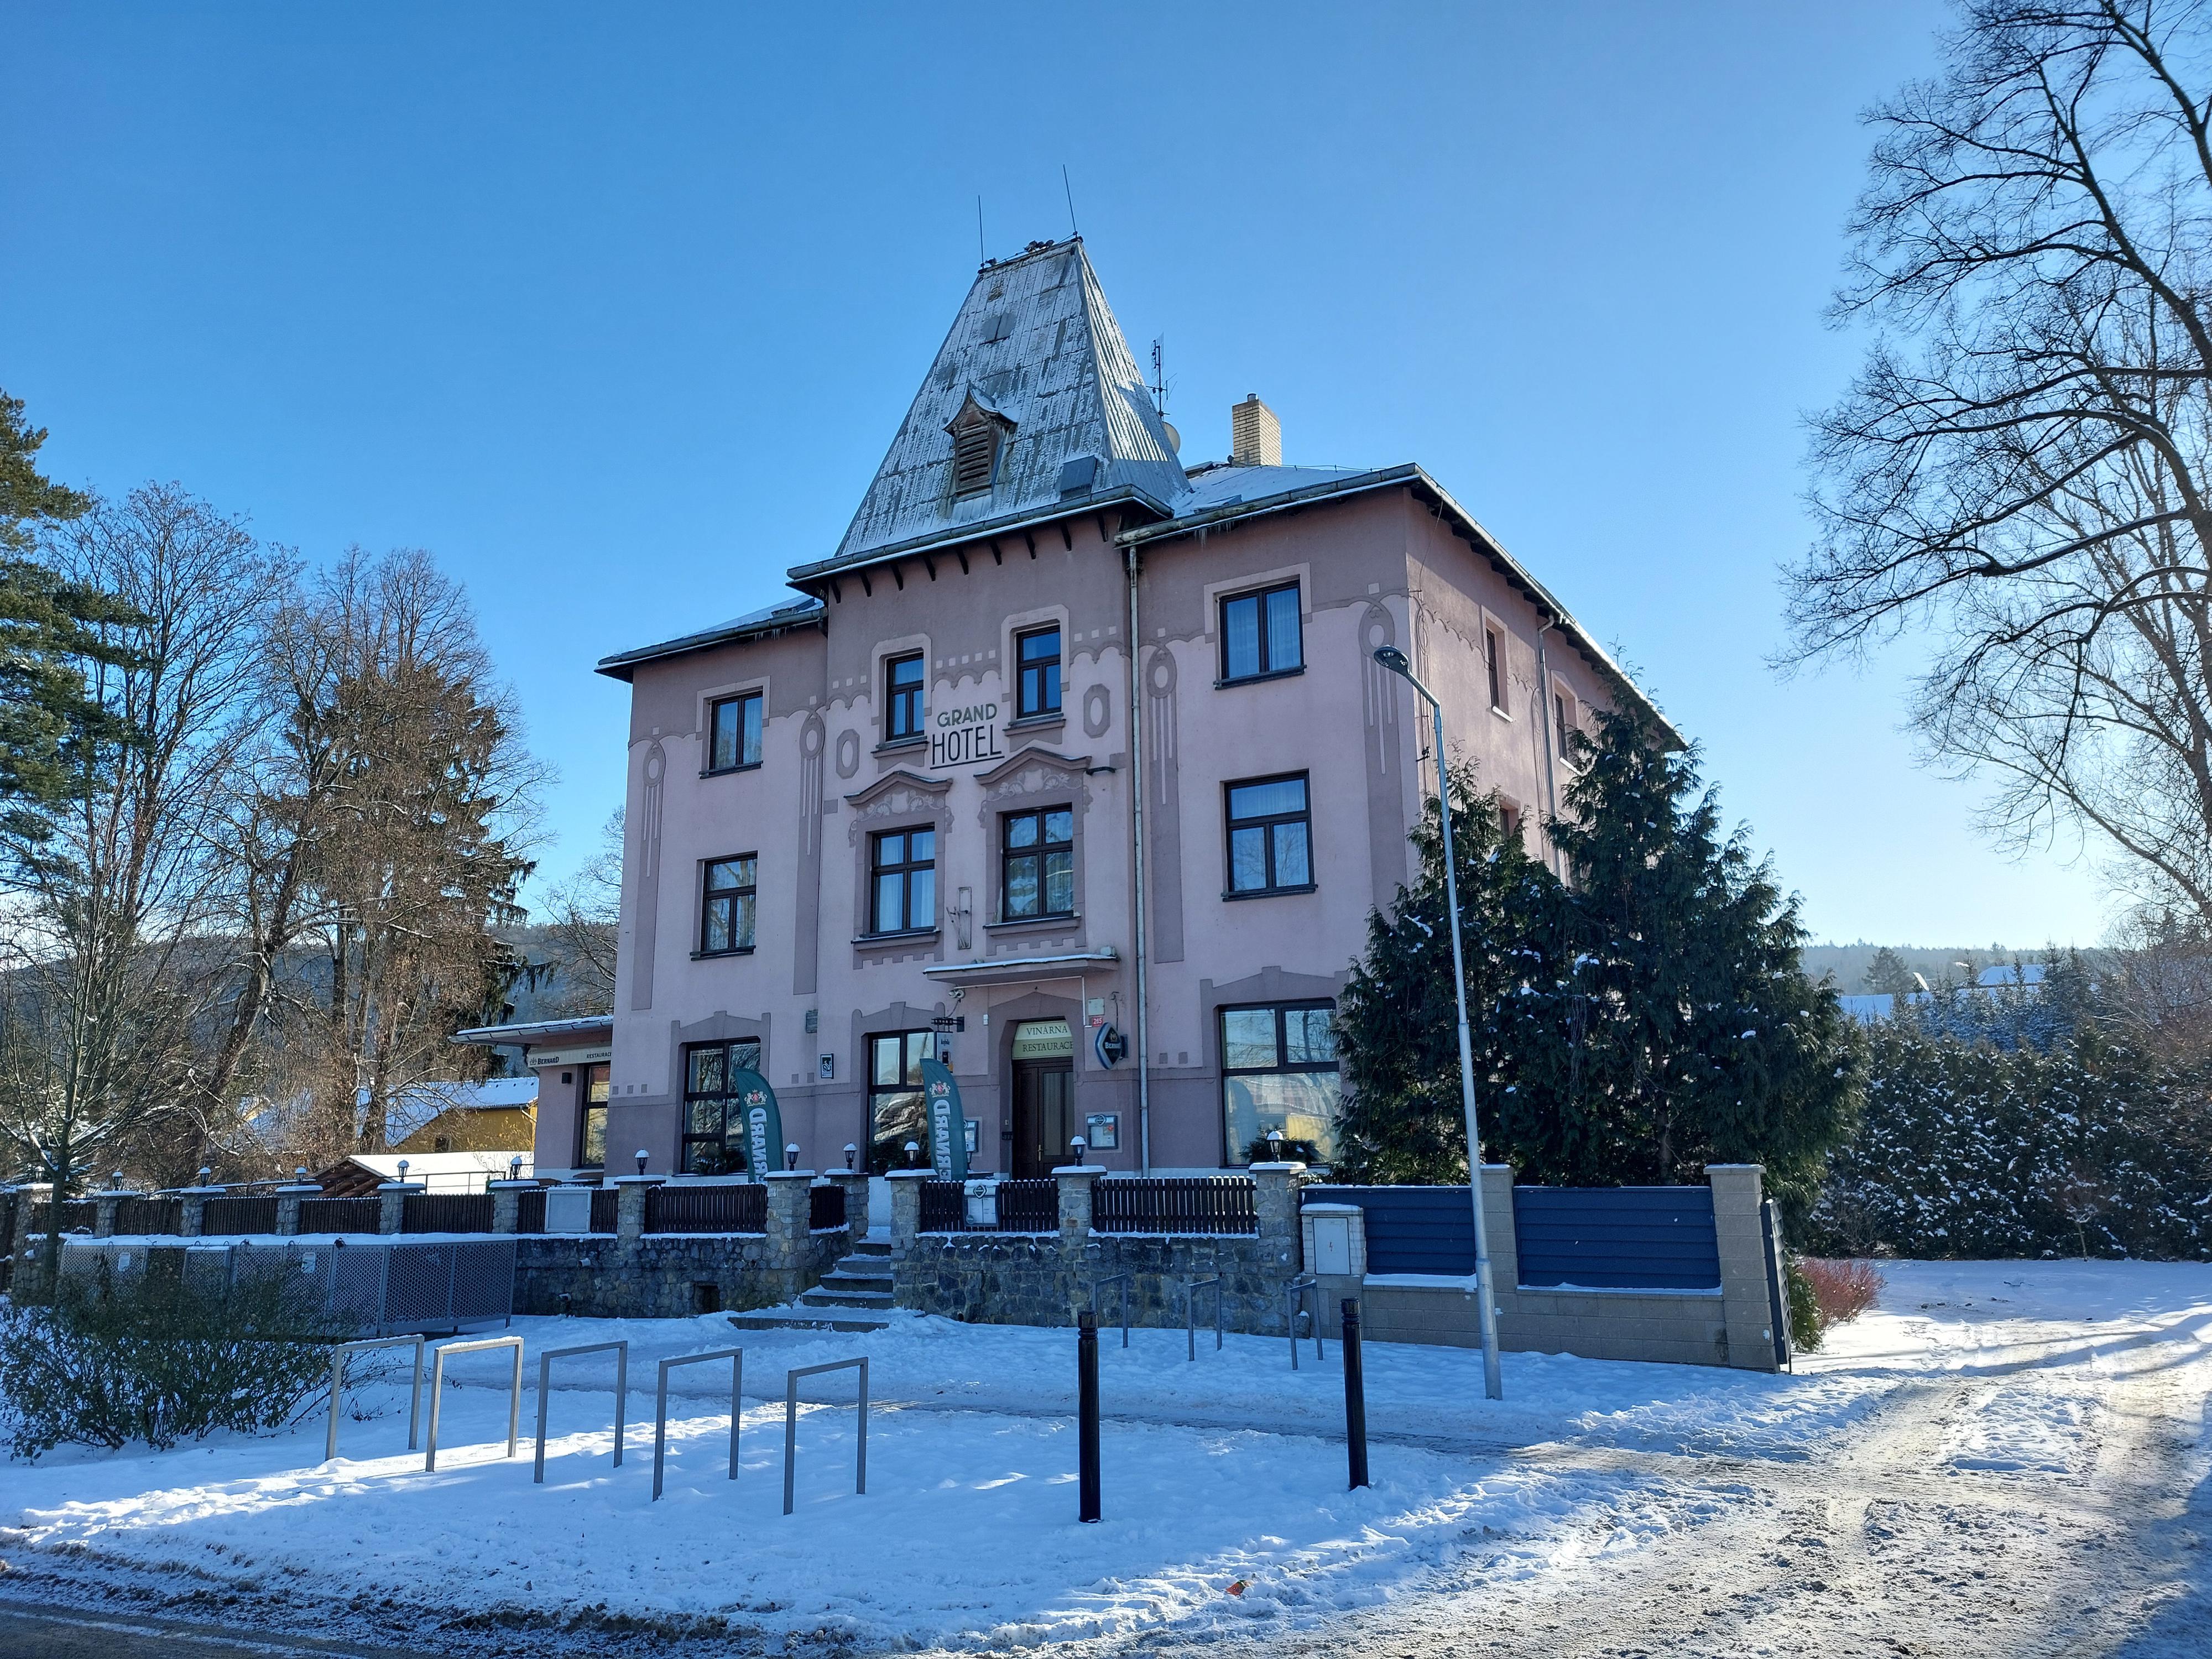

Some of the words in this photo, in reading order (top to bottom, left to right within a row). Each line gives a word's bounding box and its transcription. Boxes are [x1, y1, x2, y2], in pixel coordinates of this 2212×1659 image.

[937, 703, 997, 727] GRAND
[932, 724, 1001, 765] HOTEL
[1026, 1025, 1068, 1035] VINÁRNA
